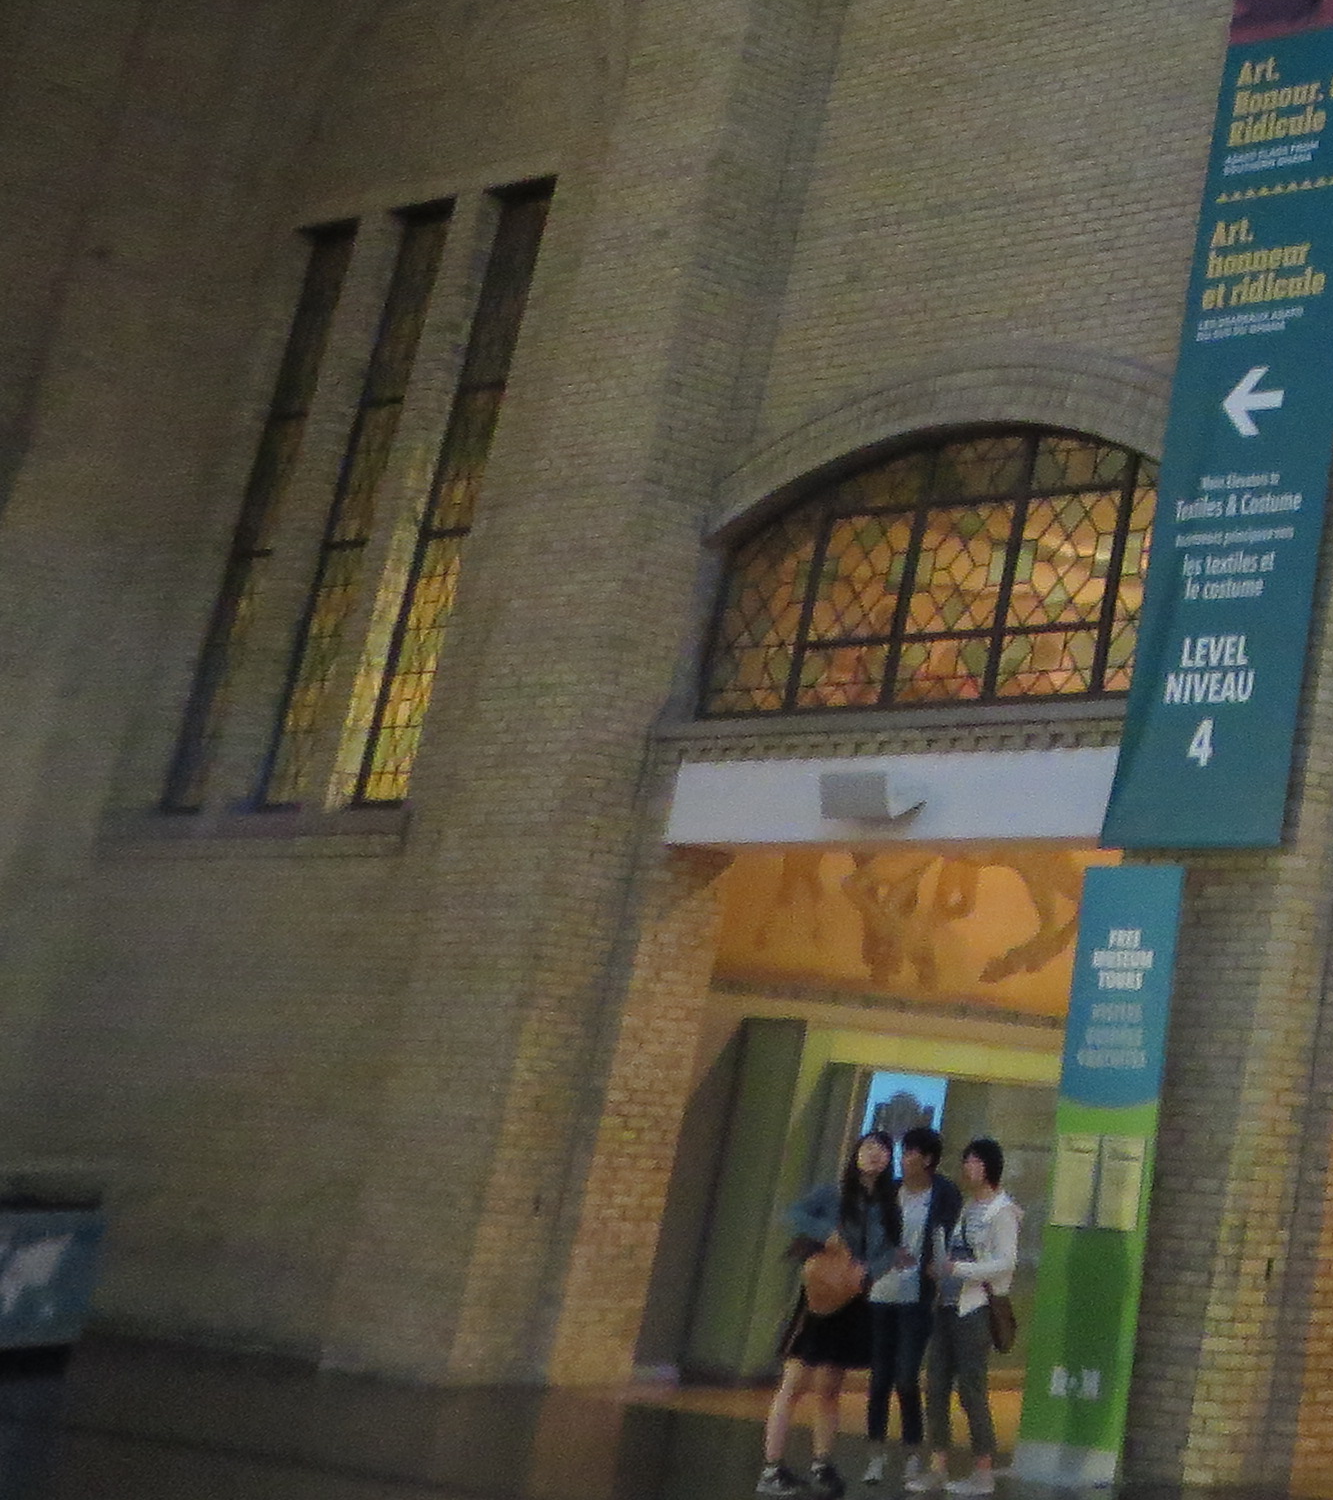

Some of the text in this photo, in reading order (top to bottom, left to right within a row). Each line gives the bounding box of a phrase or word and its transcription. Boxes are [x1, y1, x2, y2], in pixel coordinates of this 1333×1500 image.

[1226, 104, 1326, 147] Ridicule
[1205, 242, 1312, 278] honneur
[1202, 266, 1326, 310] et ridicule
[1175, 491, 1303, 521] Textiles & Costume
[1182, 550, 1276, 577] les textiles et
[1184, 576, 1265, 601] le costume
[1180, 634, 1249, 668] LEVEL
[1164, 669, 1256, 705] NIVEAU
[1186, 716, 1214, 768] 4
